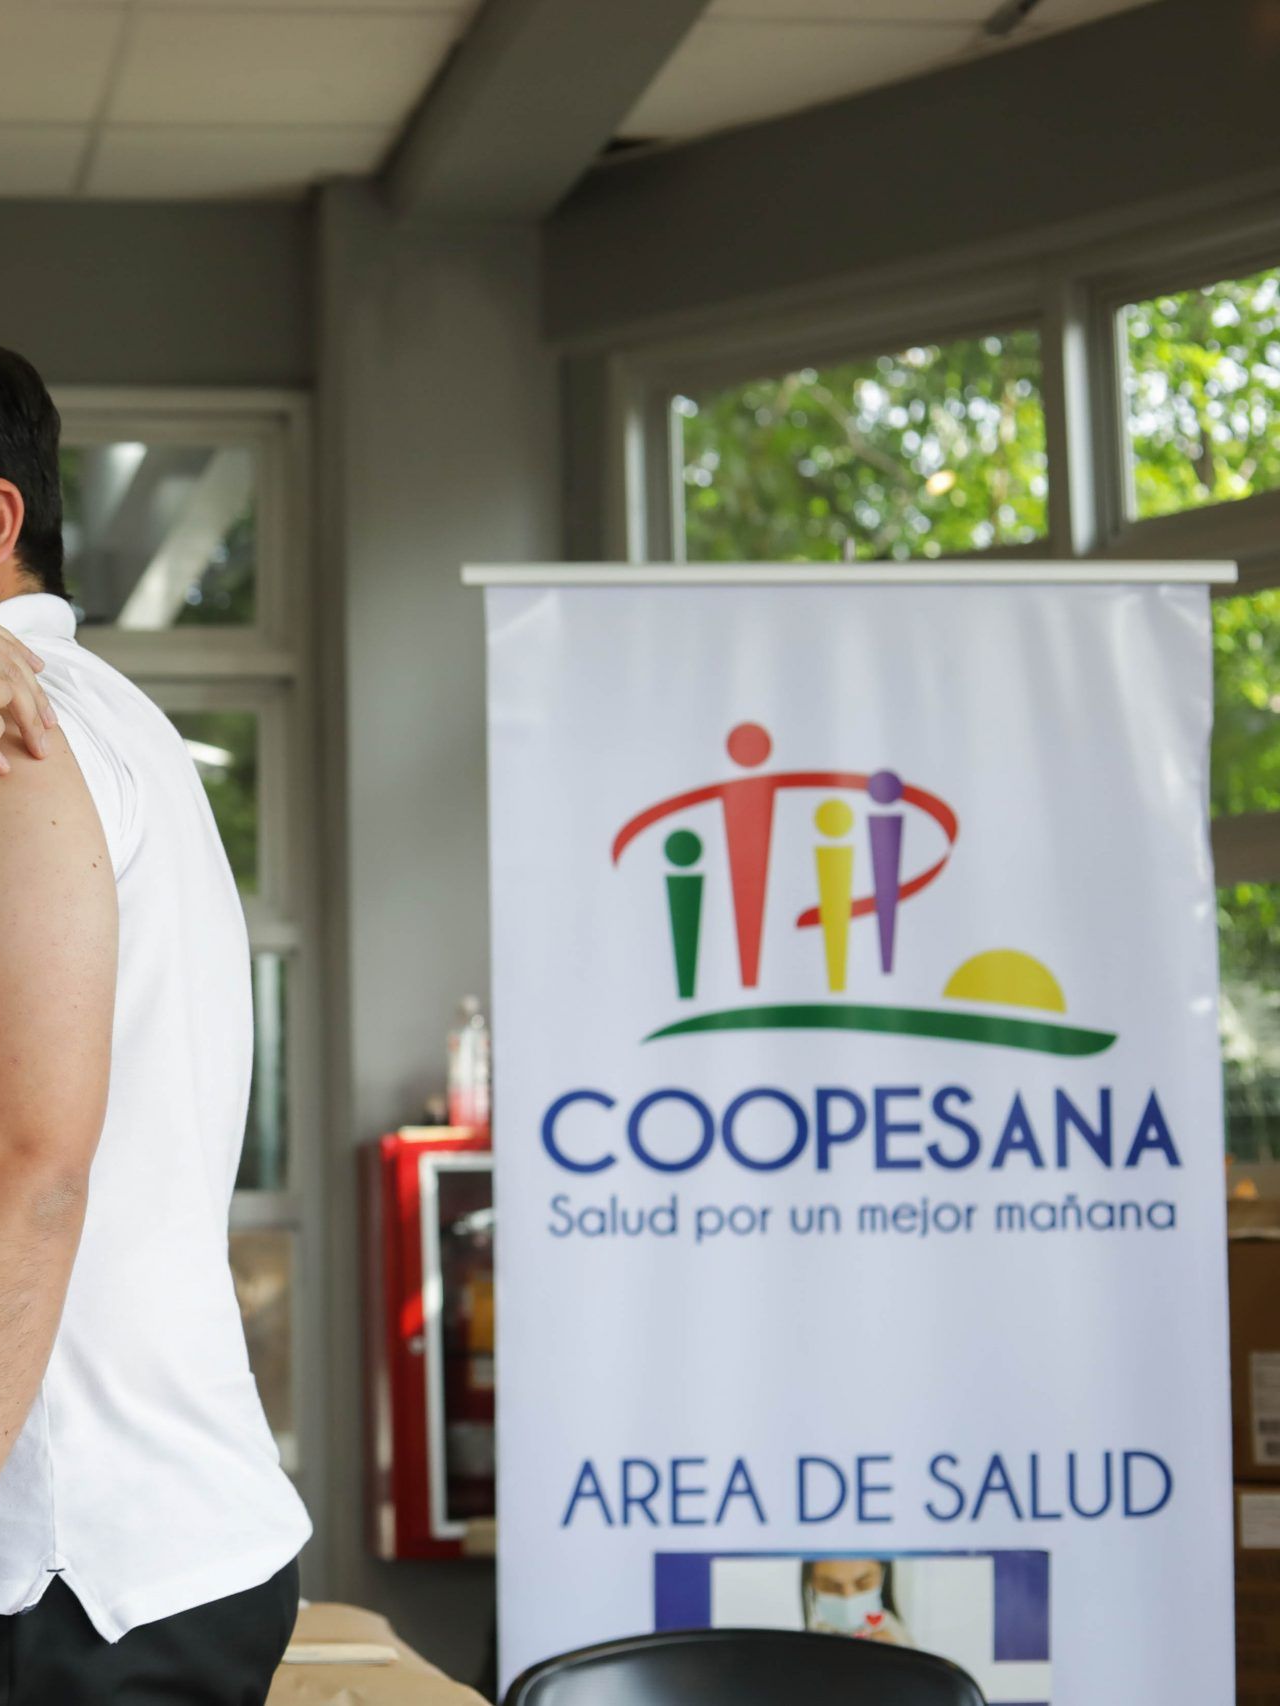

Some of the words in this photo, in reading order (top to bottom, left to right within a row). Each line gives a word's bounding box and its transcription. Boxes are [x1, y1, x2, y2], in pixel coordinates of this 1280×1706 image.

[540, 1084, 1183, 1175] COOPESANA
[548, 1193, 680, 1238] Salud
[694, 1203, 772, 1244] por
[789, 1203, 842, 1236] un
[857, 1197, 978, 1239] mejor
[995, 1193, 1178, 1232] mañana
[561, 1457, 768, 1528] AREA
[796, 1454, 893, 1525] DE
[925, 1449, 1174, 1523] SALUD
